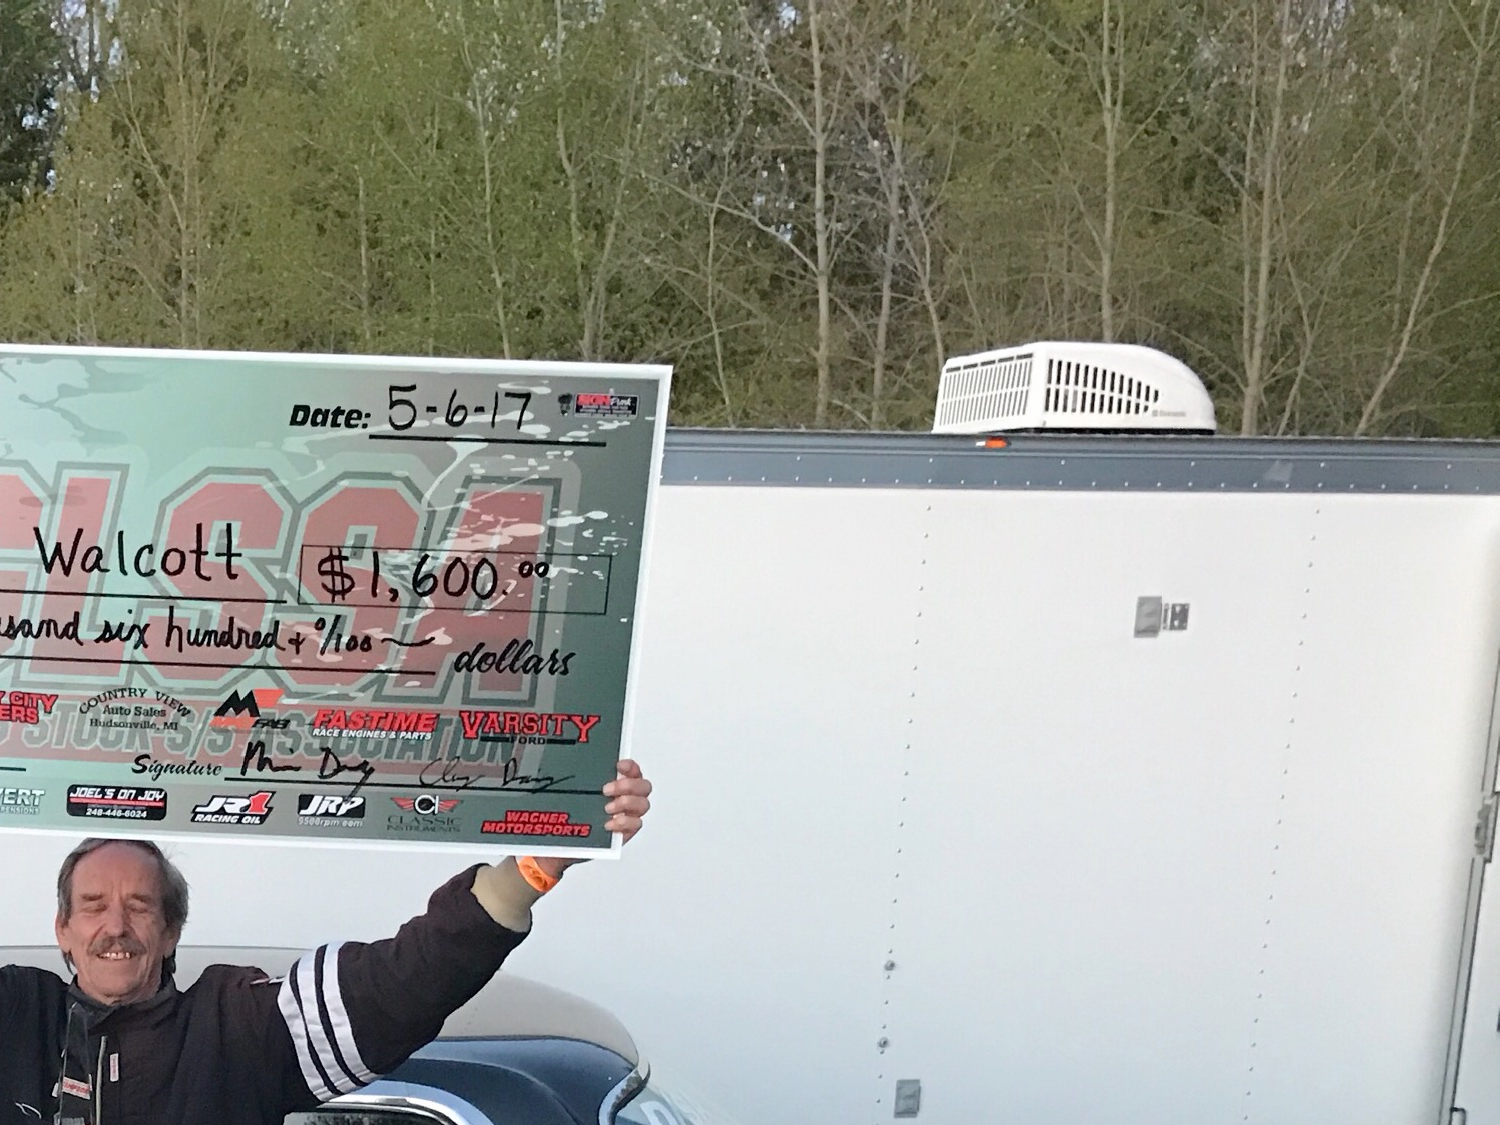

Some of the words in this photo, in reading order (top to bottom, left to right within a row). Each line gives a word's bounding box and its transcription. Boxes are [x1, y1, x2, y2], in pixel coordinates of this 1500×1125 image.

[289, 402, 371, 430] Date:
[387, 384, 532, 432] 5-6-17
[33, 522, 243, 581] Walcott
[96, 609, 149, 650] six
[164, 605, 286, 653] hundred
[454, 639, 576, 676] dollars
[9, 691, 59, 713] CITY
[79, 687, 148, 714] COUNTRY
[155, 690, 192, 718] VIEW
[102, 704, 132, 716] Auto
[134, 706, 167, 717] Sales
[313, 708, 441, 733] FASTIME
[459, 710, 601, 743] VARSITY
[313, 729, 339, 738] RACE
[342, 729, 387, 739] ENGINES
[388, 731, 396, 739] &
[399, 731, 432, 741] PARTS
[510, 736, 546, 745] FORD
[131, 753, 222, 781] Signature
[117, 788, 136, 800] ON
[138, 790, 165, 802] JOY
[85, 808, 147, 818] 248-446-6024
[194, 813, 238, 824] RACING
[241, 815, 261, 824] OIL
[505, 811, 569, 823] WAGNER
[481, 821, 591, 837] MOTORSPORTS
